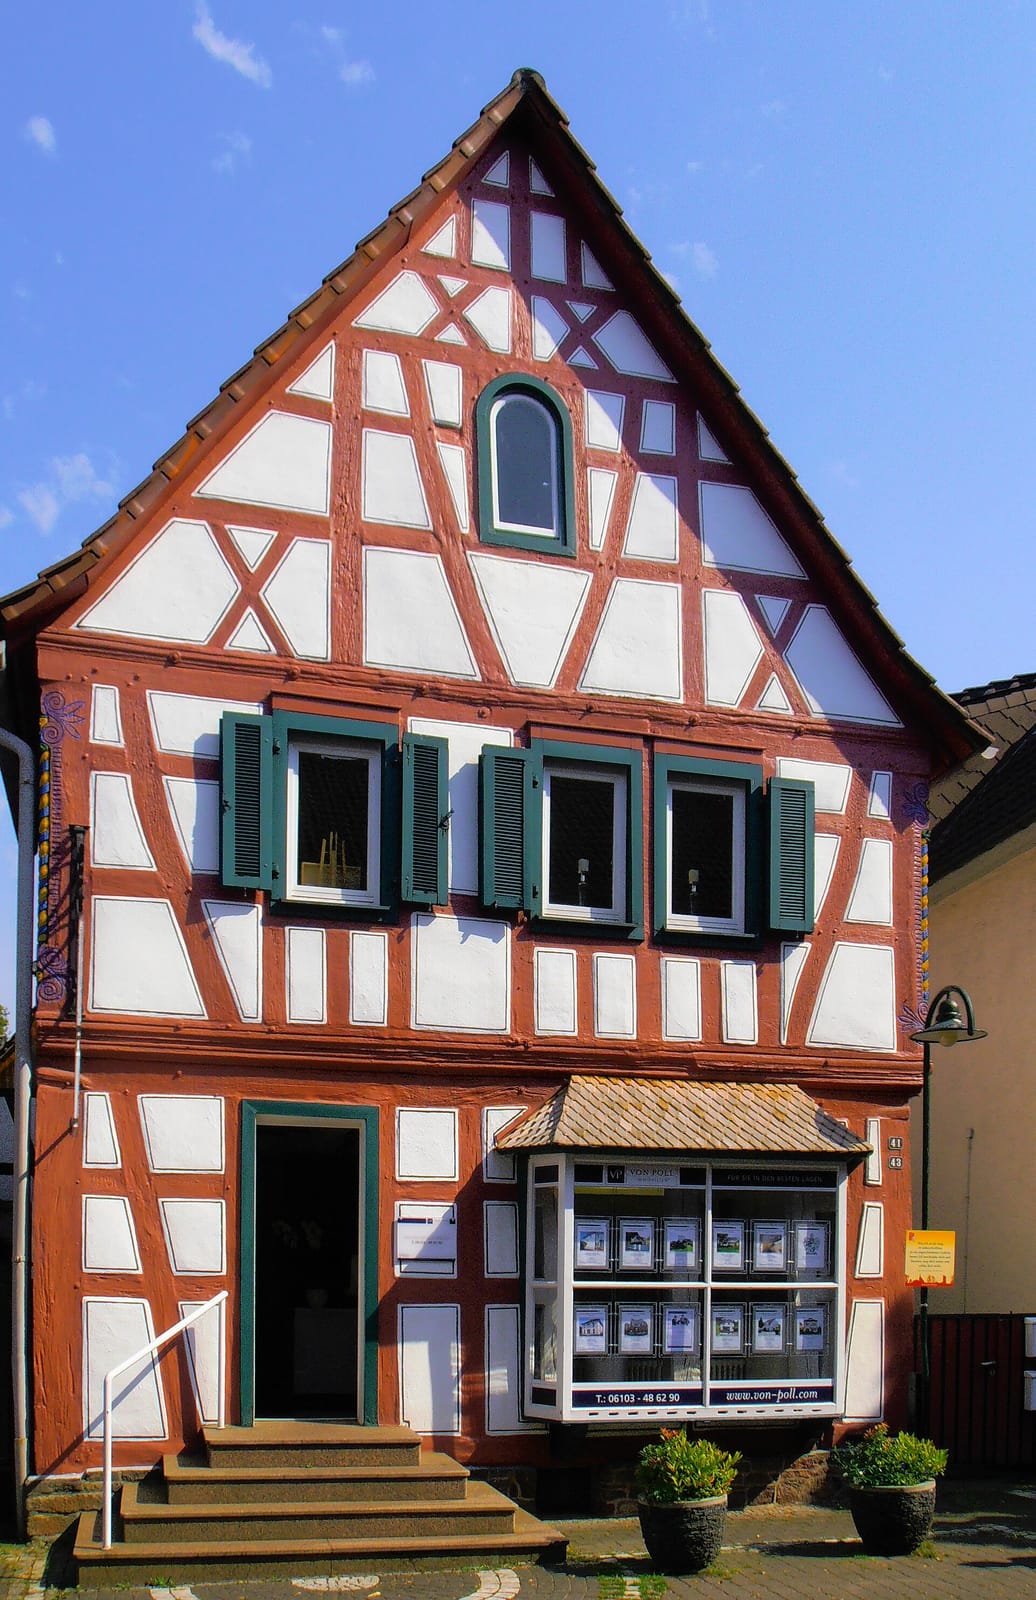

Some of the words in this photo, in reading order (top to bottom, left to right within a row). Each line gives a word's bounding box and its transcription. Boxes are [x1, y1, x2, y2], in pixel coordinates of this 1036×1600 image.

[890, 1138, 901, 1148] 41
[890, 1157, 902, 1167] 43
[630, 1168, 650, 1176] VON
[652, 1168, 674, 1177] POLL
[595, 1394, 606, 1404] T.:
[608, 1394, 635, 1403] 06103
[642, 1393, 654, 1403] 48
[656, 1393, 667, 1402] 62
[669, 1393, 680, 1402] 90
[726, 1387, 818, 1403] www.von-poll.com
